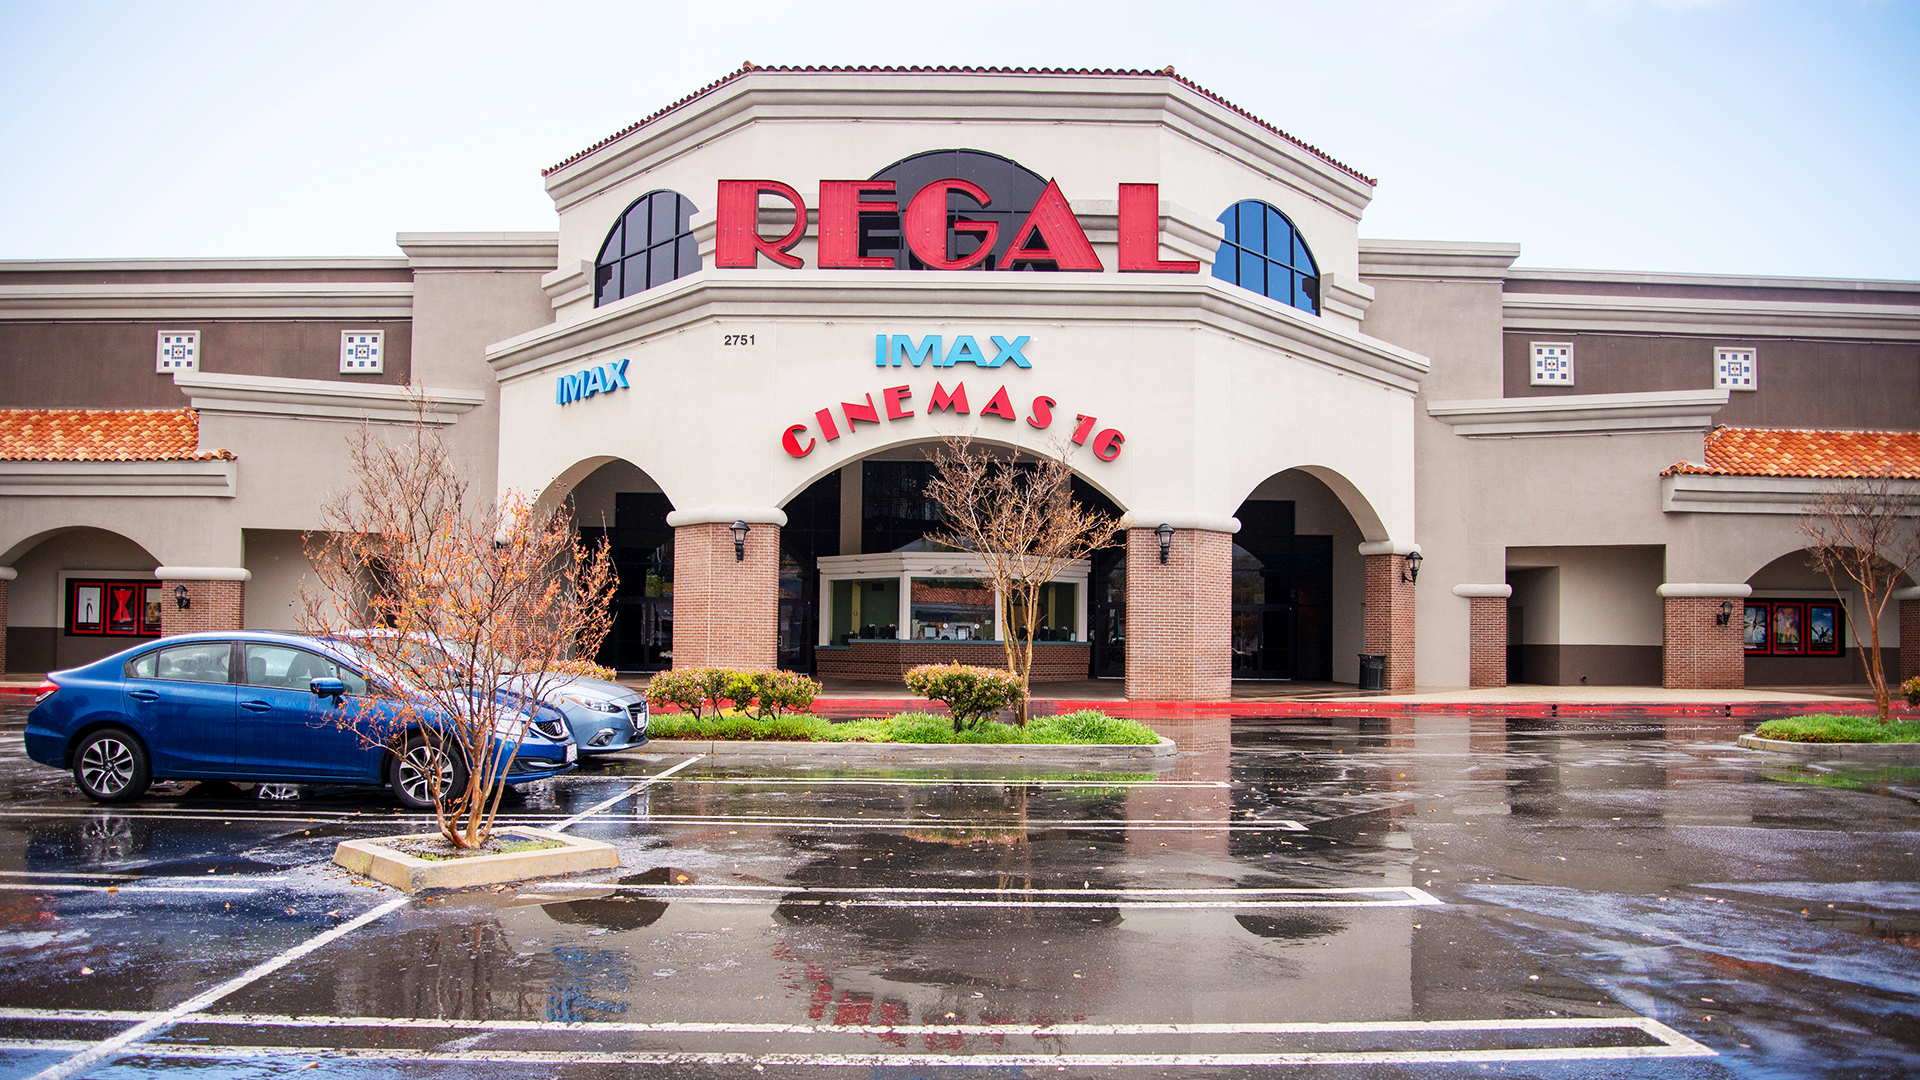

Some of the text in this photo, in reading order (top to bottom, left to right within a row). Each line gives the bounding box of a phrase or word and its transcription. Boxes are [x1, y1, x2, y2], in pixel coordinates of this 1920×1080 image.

[715, 177, 1201, 273] REGAL
[724, 334, 755, 346] 2751
[876, 334, 1033, 368] IMAX
[556, 358, 630, 405] IMAX
[781, 381, 1126, 462] CINEMAS 16
